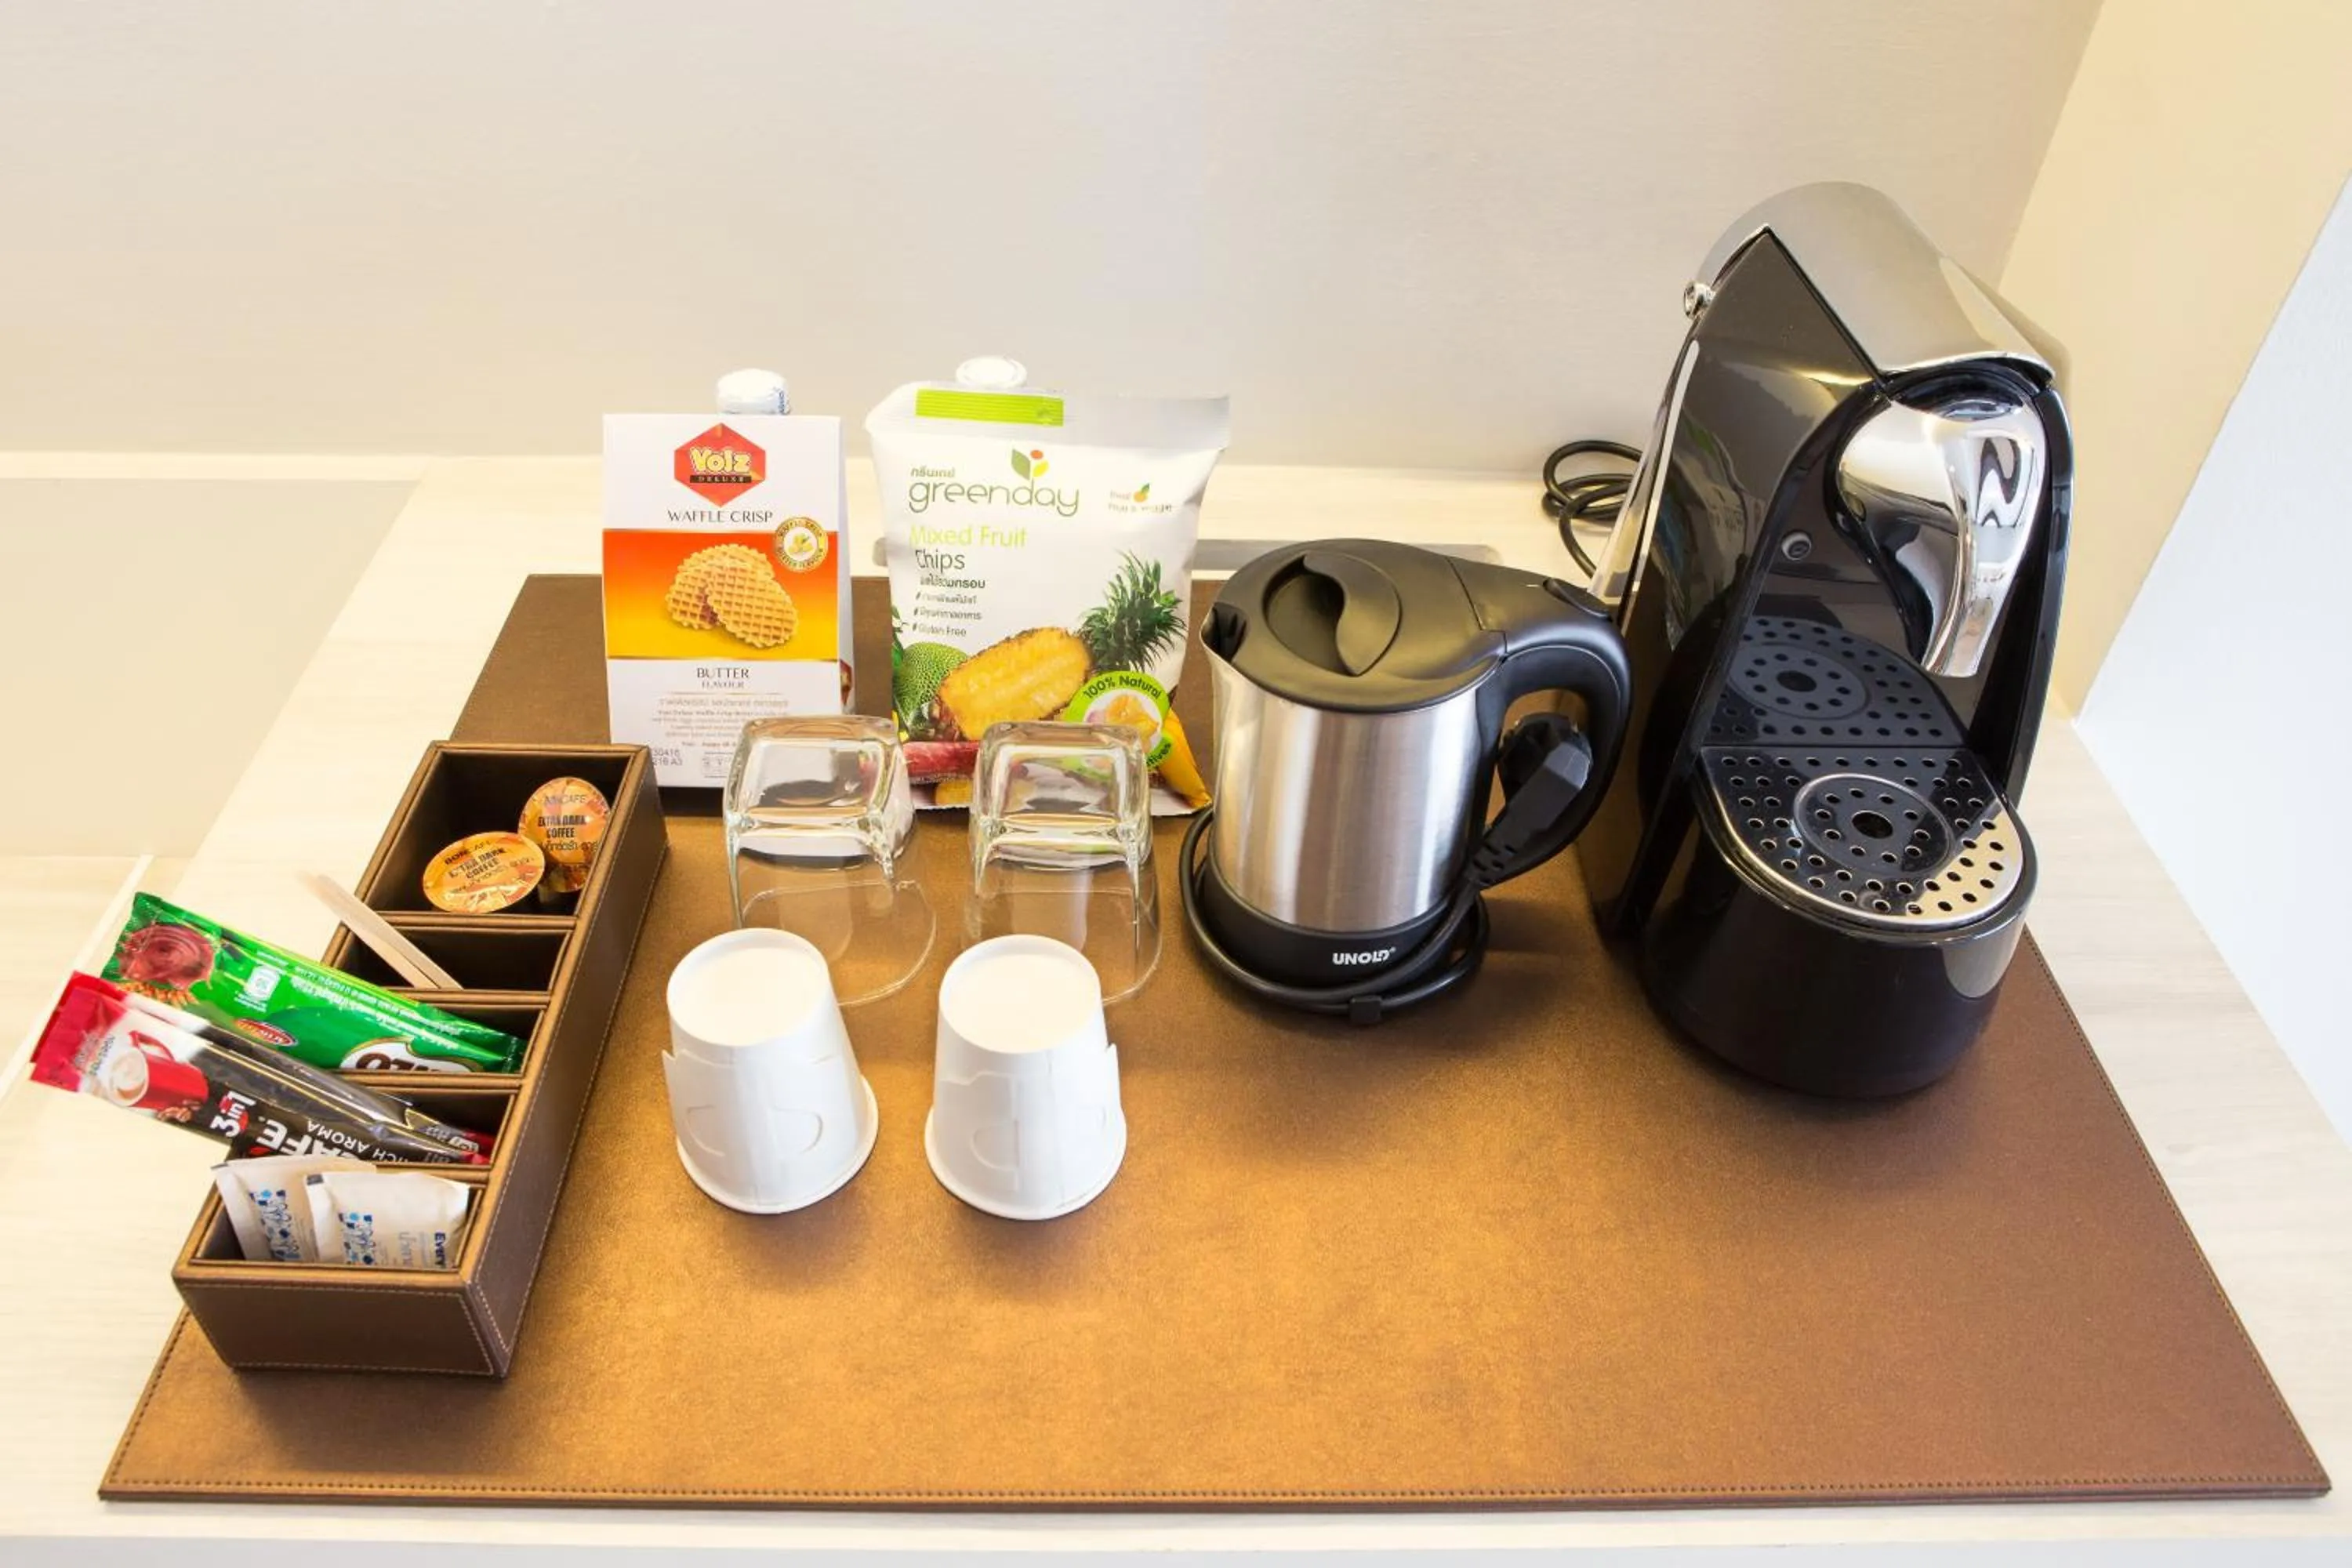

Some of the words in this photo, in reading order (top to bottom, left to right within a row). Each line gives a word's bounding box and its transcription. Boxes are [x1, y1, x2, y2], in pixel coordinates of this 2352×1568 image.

[909, 477, 1079, 517] greenday
[668, 510, 724, 523] WAFFLE
[730, 510, 773, 523] CRISP
[910, 524, 972, 546] Mixed
[980, 526, 1027, 547] Fruit
[915, 549, 966, 574] Chips
[946, 626, 967, 637] Free
[697, 667, 749, 679] BUTTER
[702, 681, 745, 689] FLAVOUR
[1083, 677, 1116, 699] 100%
[1120, 675, 1161, 699] Natural
[546, 827, 575, 839] COFFEE
[307, 1120, 370, 1153] AROMA
